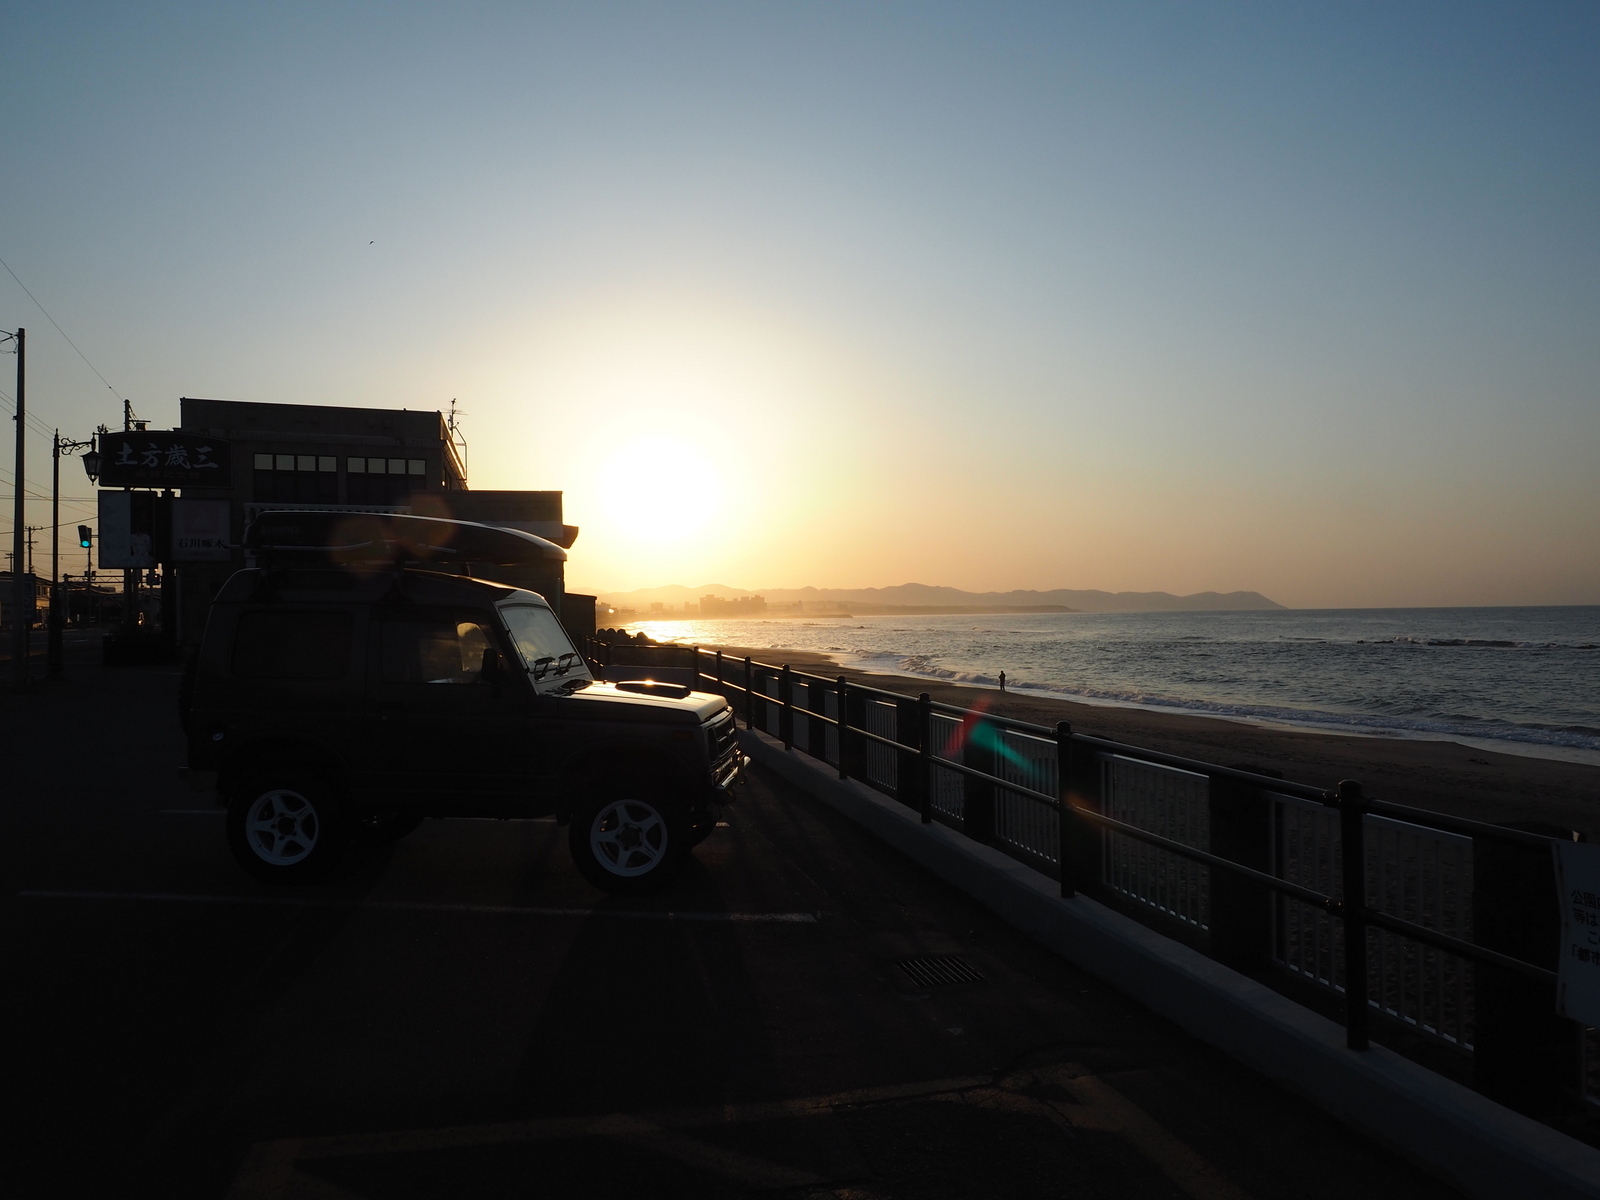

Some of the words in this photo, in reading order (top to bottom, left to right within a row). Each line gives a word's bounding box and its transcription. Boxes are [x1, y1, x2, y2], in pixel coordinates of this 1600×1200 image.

[115, 442, 219, 469] 土方歳三
[177, 538, 226, 549] 石川啄木
[1571, 889, 1600, 910] 公園
